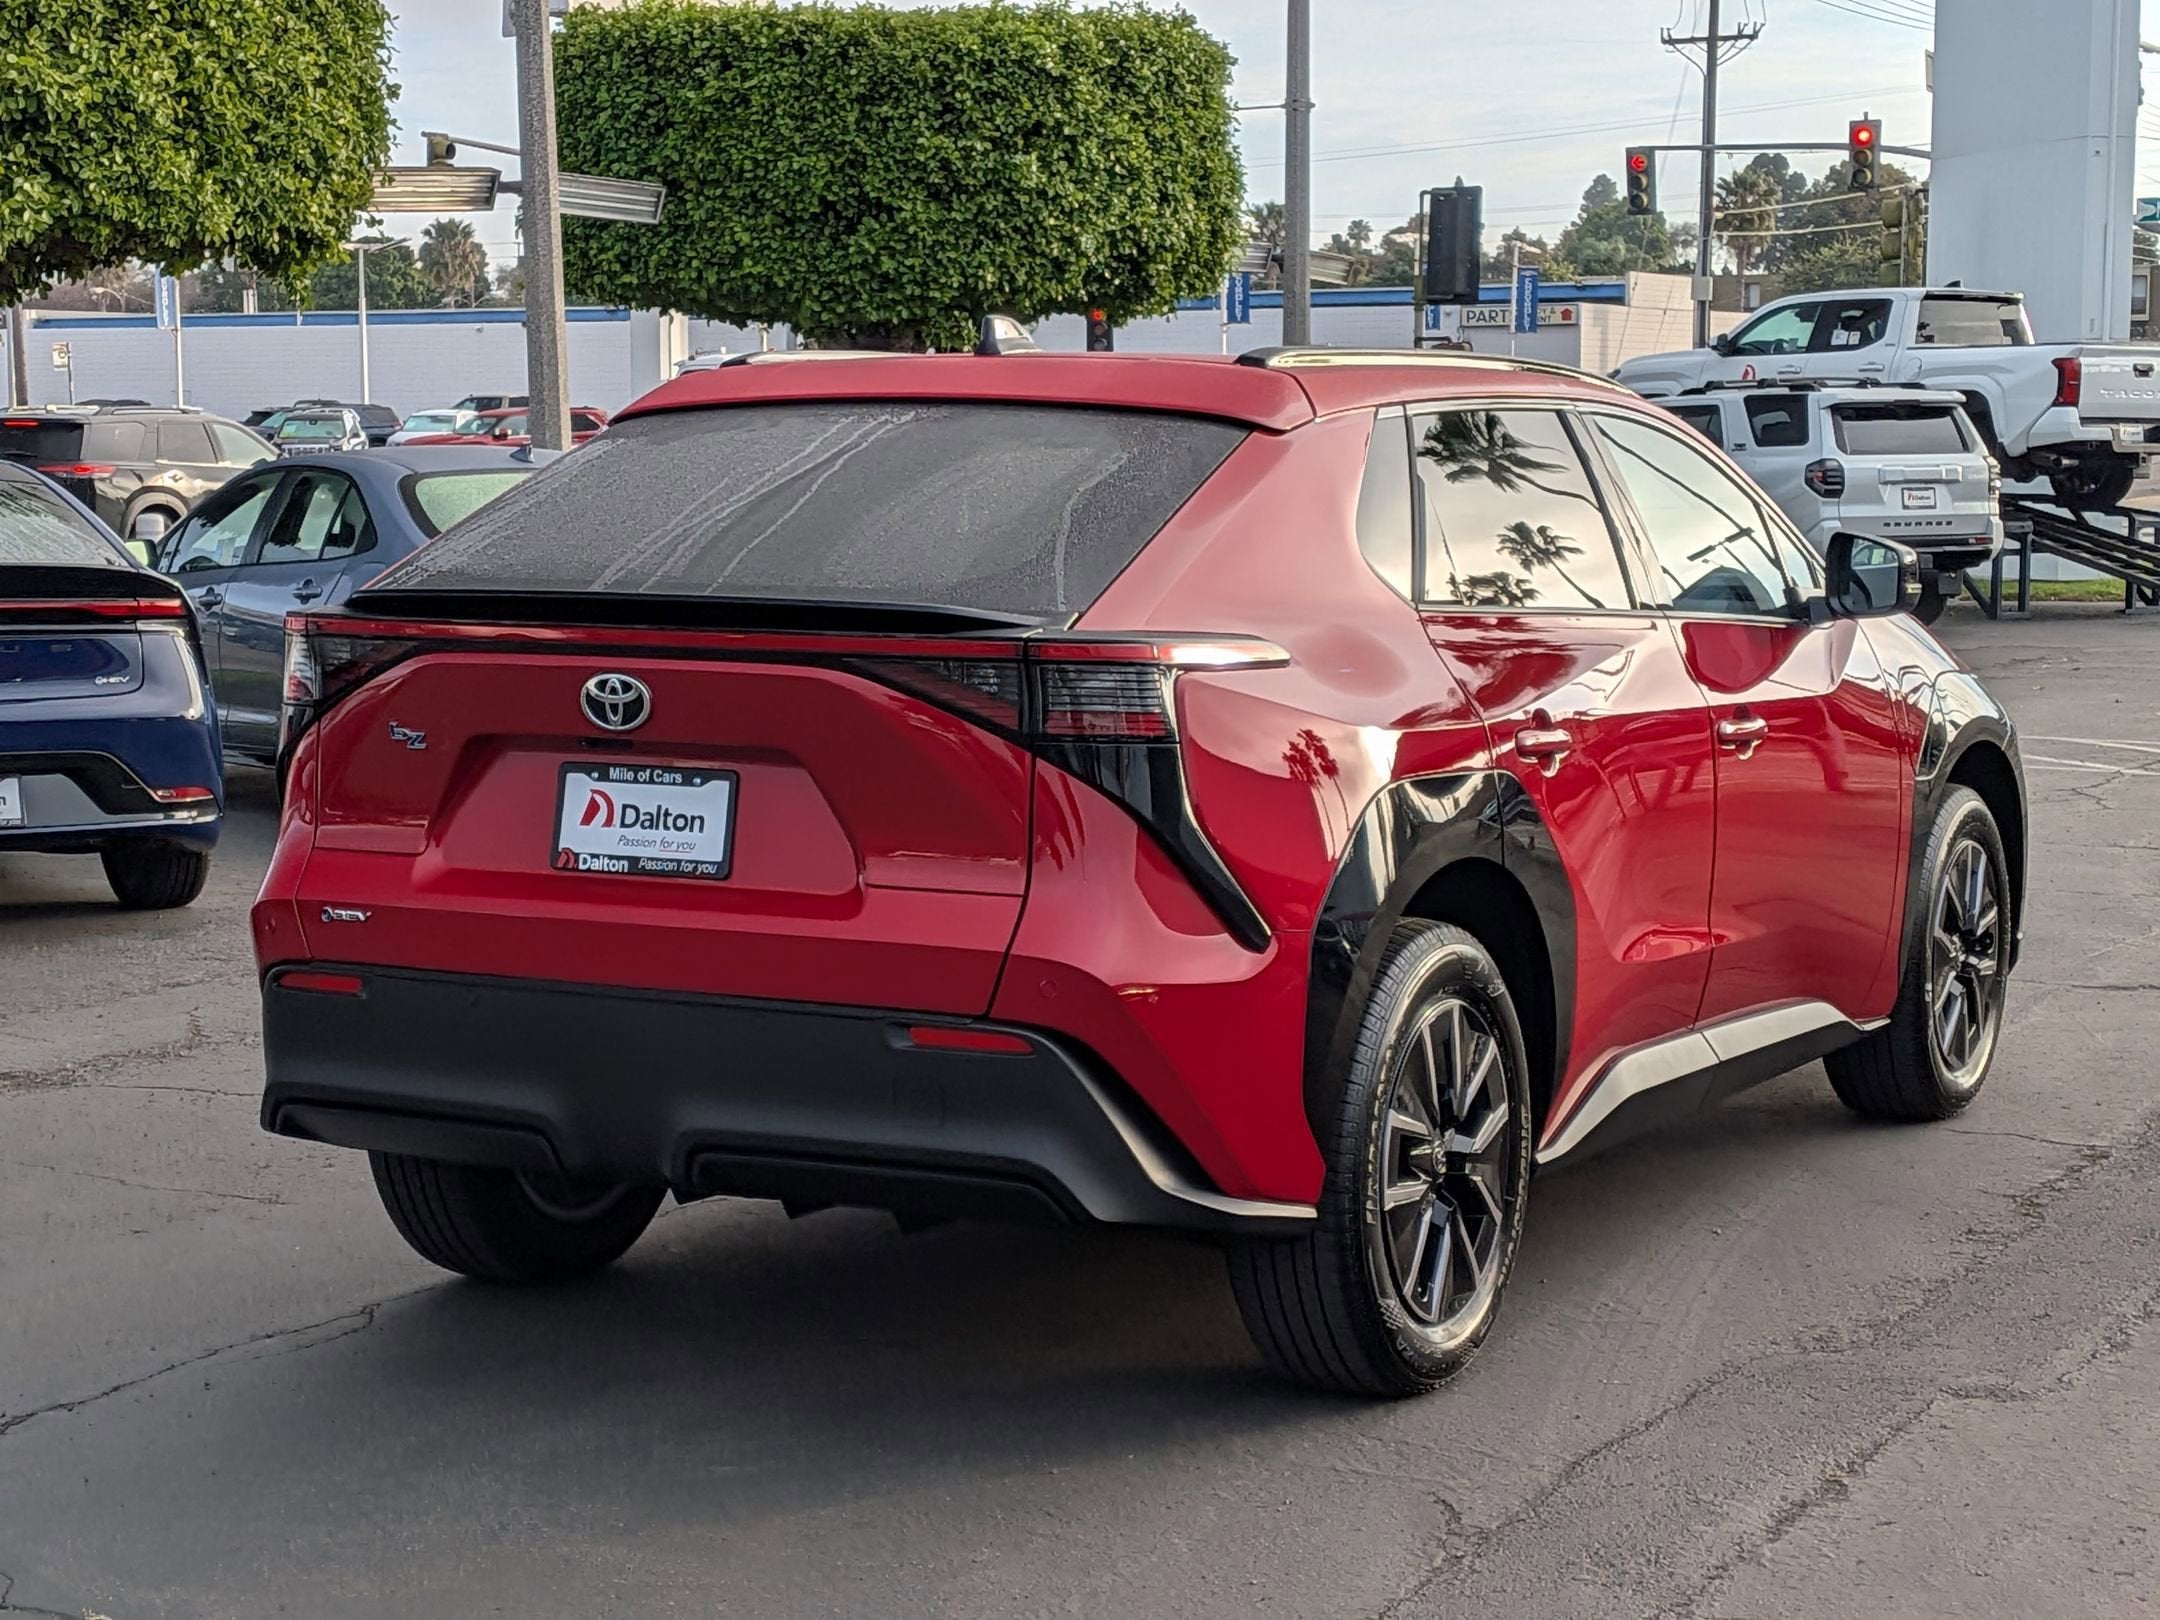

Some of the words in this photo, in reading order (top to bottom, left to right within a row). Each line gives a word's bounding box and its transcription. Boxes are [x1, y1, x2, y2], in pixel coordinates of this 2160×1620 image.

[1466, 308, 1511, 324] PART
[609, 767, 634, 781] Mile
[637, 769, 650, 782] of
[653, 769, 683, 784] Cars
[619, 803, 705, 833] Dalton
[617, 835, 657, 849] Passion
[659, 837, 675, 849] for
[676, 840, 696, 852] you
[578, 854, 629, 873] Dalton
[638, 857, 678, 872] Passion
[679, 859, 696, 874] for
[696, 862, 718, 875] you
